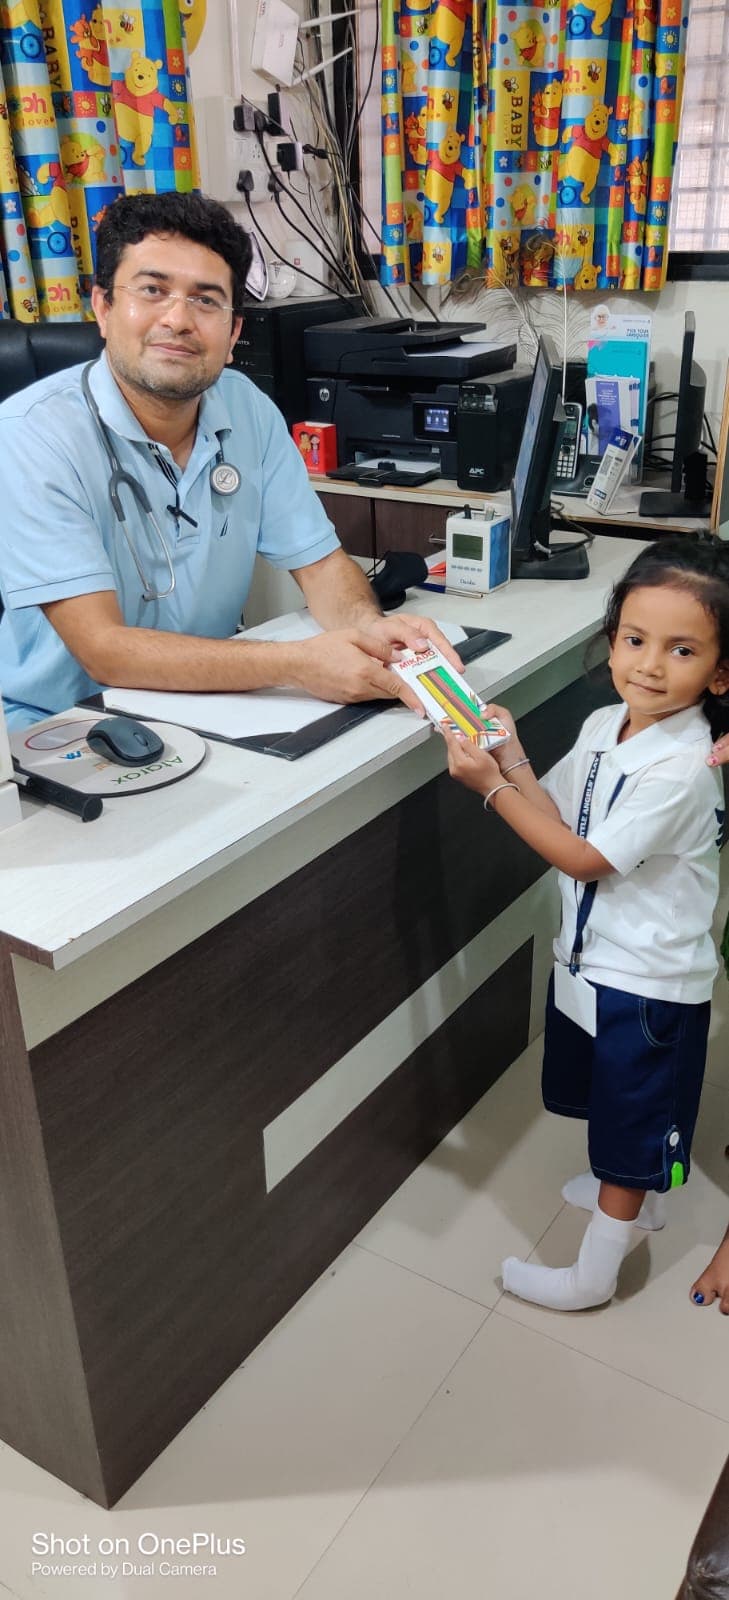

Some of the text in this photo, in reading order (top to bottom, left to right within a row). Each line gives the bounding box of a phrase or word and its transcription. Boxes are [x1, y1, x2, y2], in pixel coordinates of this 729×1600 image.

[511, 96, 523, 148] BABY
[320, 388, 330, 402] hp
[468, 467, 485, 475] APC
[399, 650, 436, 669] MIKADO
[111, 755, 184, 785] Atarax
